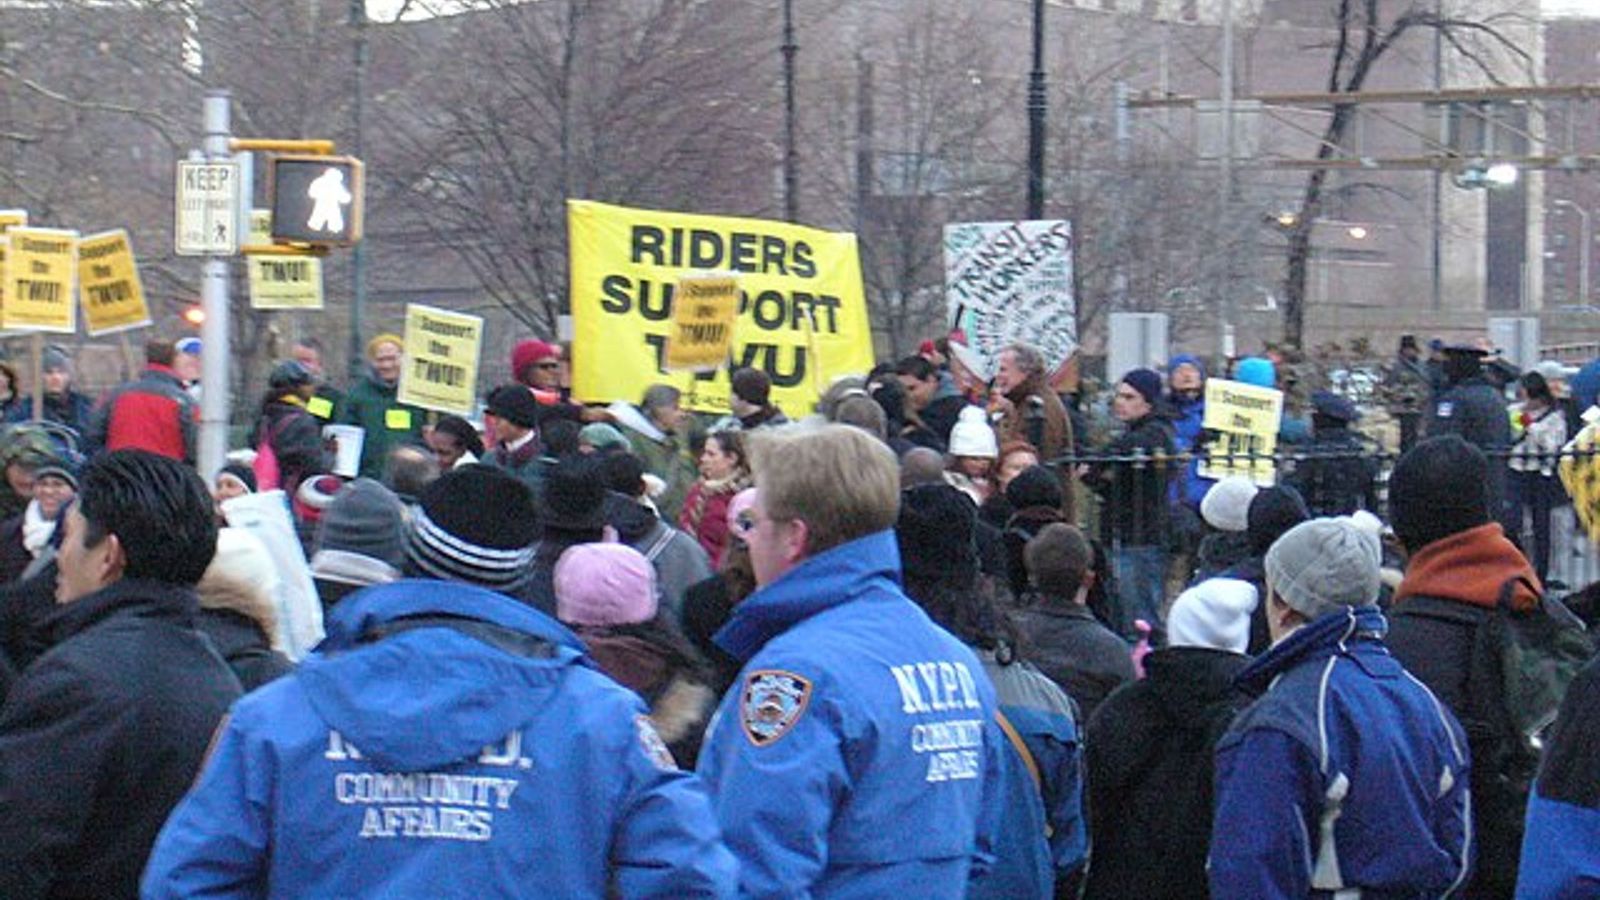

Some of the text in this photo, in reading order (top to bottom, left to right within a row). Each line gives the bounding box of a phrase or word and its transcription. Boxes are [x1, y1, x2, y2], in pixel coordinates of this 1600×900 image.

[184, 167, 229, 191] KEEP
[631, 225, 817, 278] RIDERS
[952, 222, 1028, 300] TRANSIT
[970, 222, 1072, 304] WORKERS
[600, 275, 841, 333] SUORT
[420, 315, 475, 340] Support
[428, 340, 450, 357] the
[334, 772, 519, 809] COMMUNITY
[358, 805, 494, 841] AFFAIRS
